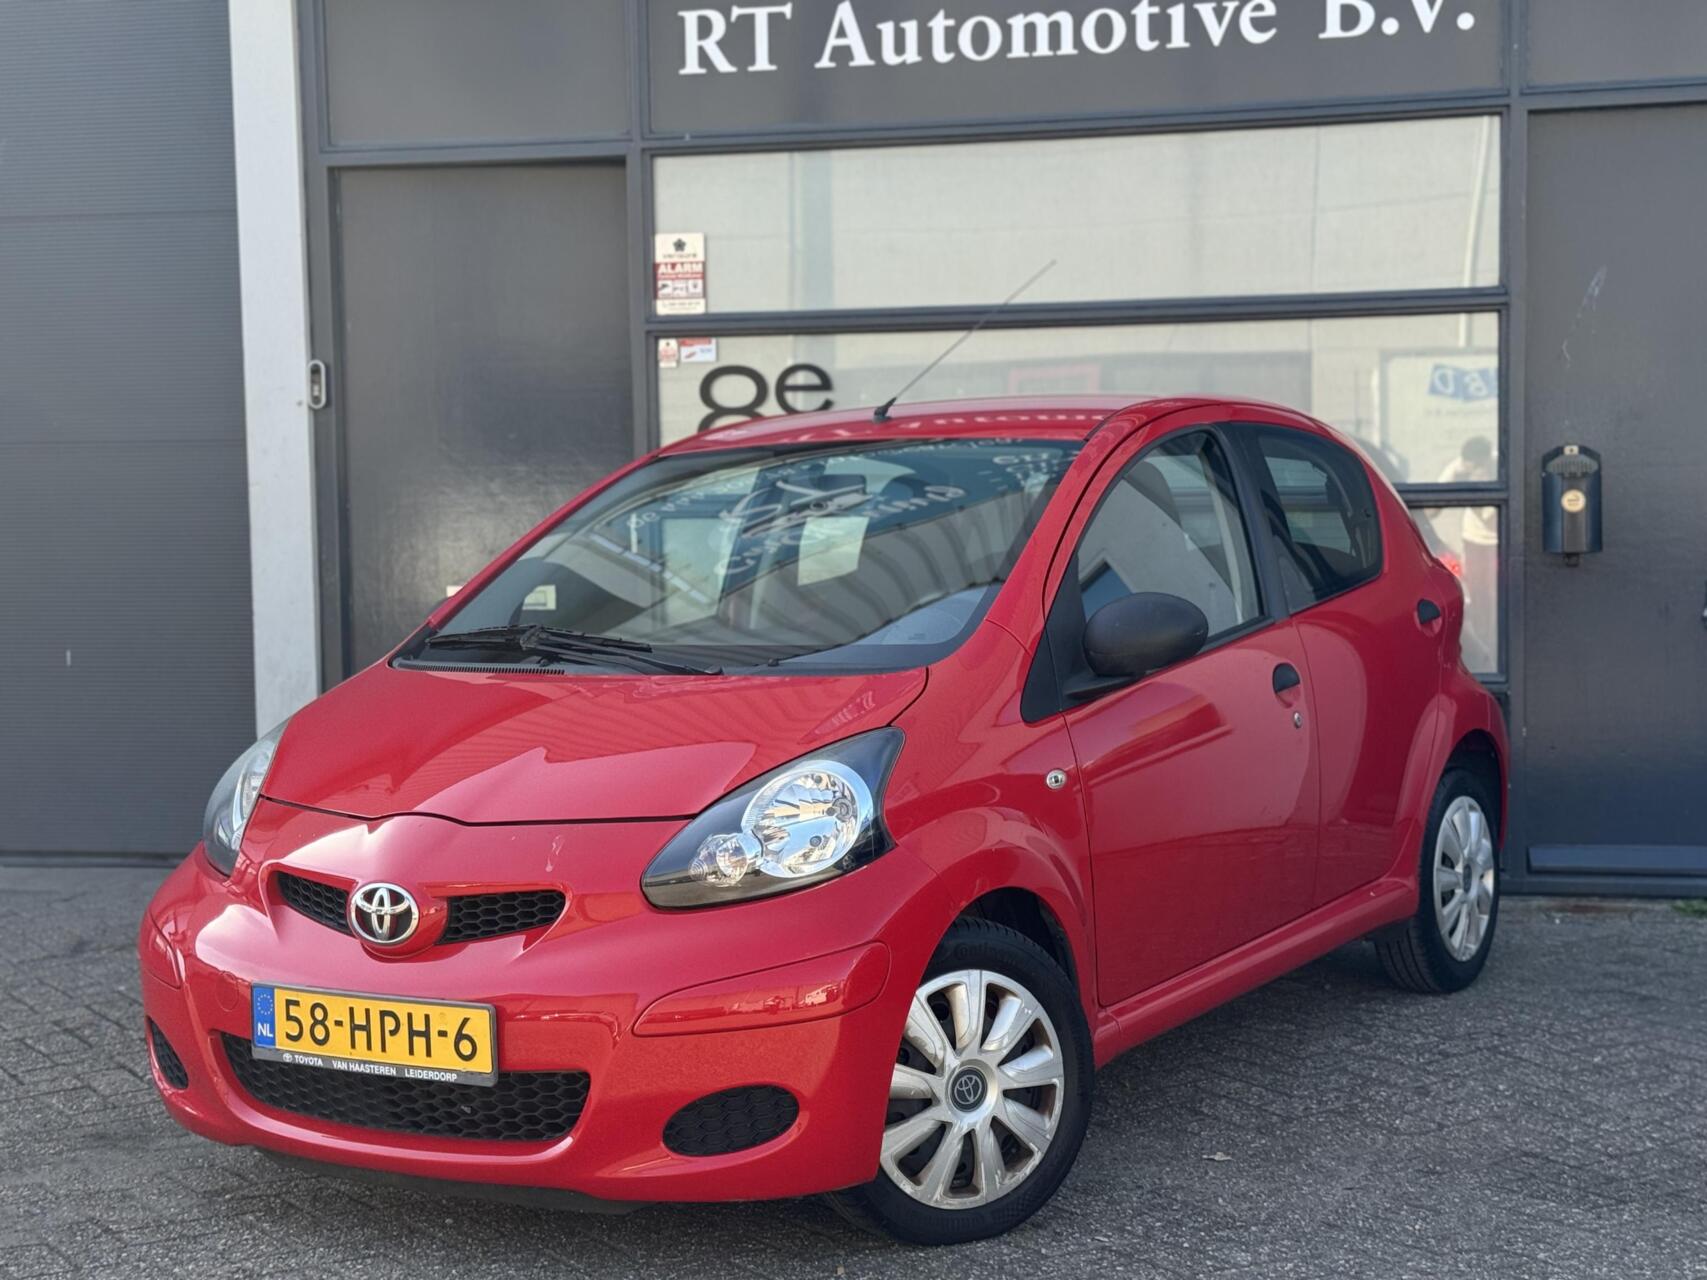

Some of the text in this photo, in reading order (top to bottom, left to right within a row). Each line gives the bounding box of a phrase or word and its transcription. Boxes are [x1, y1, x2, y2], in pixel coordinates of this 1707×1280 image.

[677, 2, 793, 75] RT
[814, 0, 1278, 69] Automotive
[657, 262, 704, 274] ALARM
[257, 1022, 274, 1038] NL
[284, 998, 478, 1062] 58-HPH-6
[294, 1054, 458, 1083] TOYOTA VAN HAASTEREN LEIDERDORP
